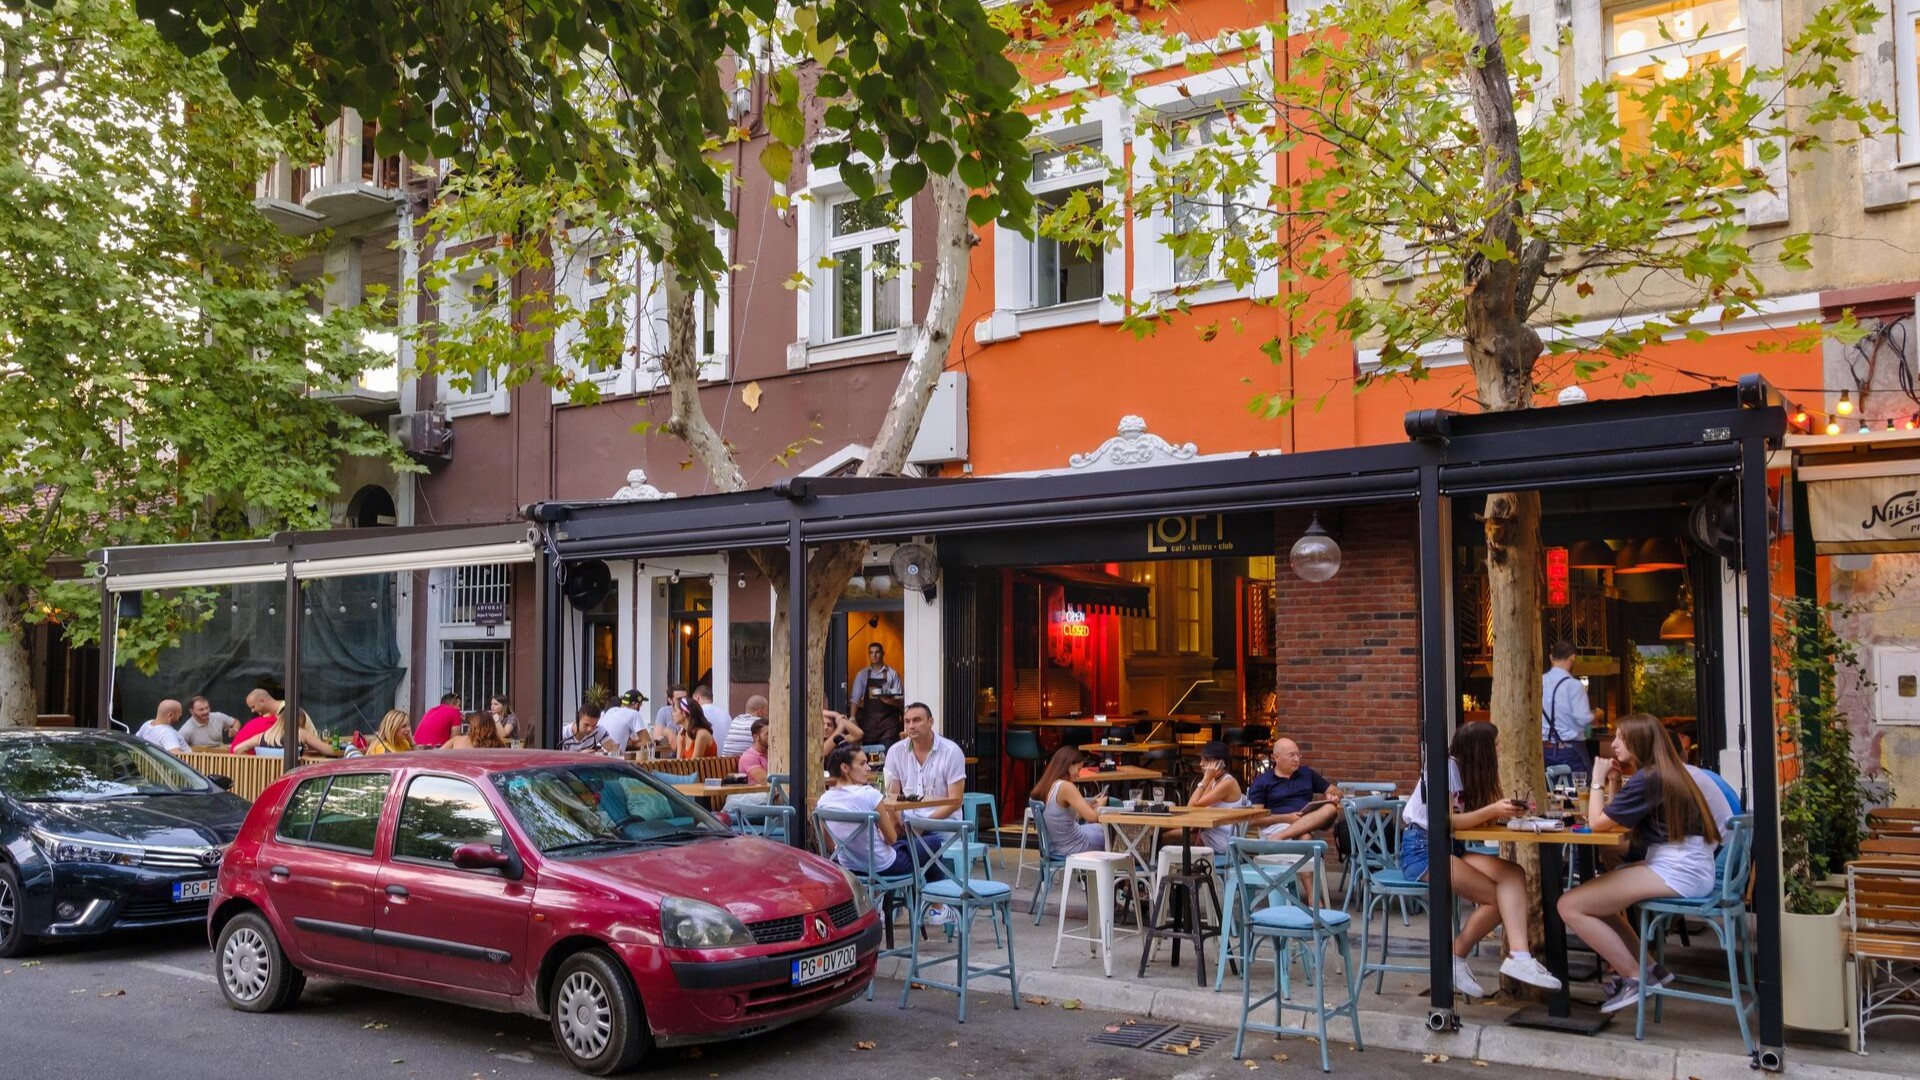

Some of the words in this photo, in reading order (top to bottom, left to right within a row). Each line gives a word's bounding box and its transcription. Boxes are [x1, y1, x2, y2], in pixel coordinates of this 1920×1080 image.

[1192, 542, 1212, 551] bistro
[1218, 542, 1234, 550] club
[1066, 610, 1086, 622] OPEN
[487, 627, 495, 636] 10
[1063, 624, 1090, 637] CLOSED
[183, 882, 200, 896] PG
[801, 959, 816, 979] PG
[823, 946, 855, 972] DV700
